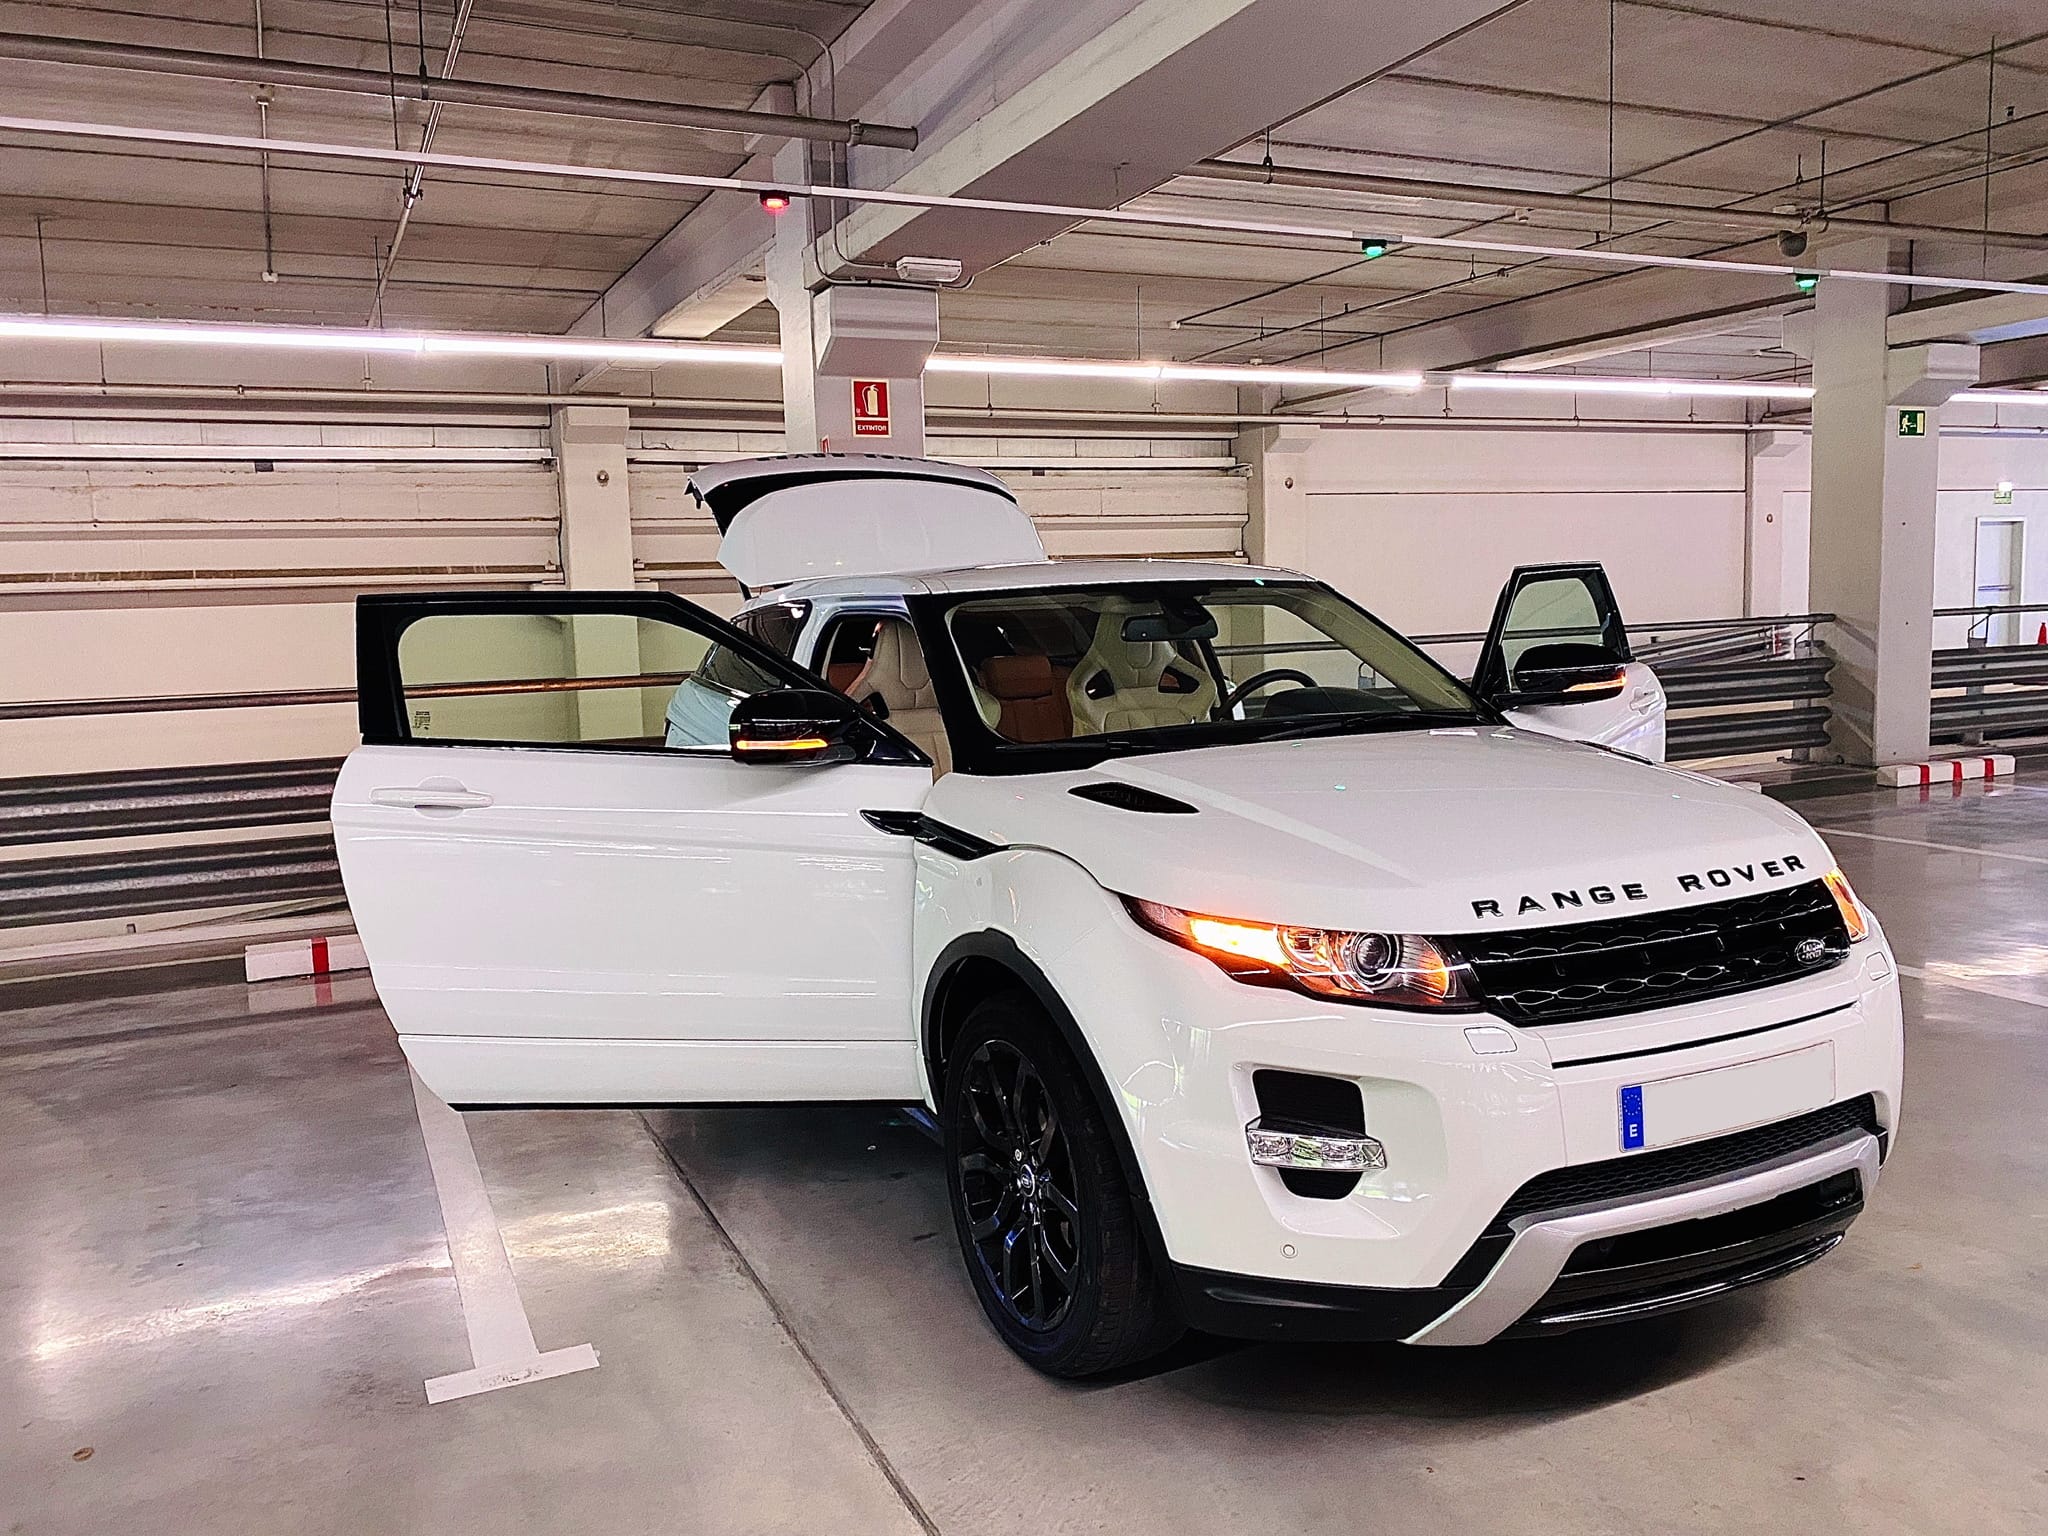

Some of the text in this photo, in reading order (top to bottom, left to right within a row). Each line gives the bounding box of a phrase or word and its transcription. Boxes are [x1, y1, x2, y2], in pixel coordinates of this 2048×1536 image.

[1471, 855, 1806, 919] RANGE ROVER
[1629, 1123, 1638, 1137] E
